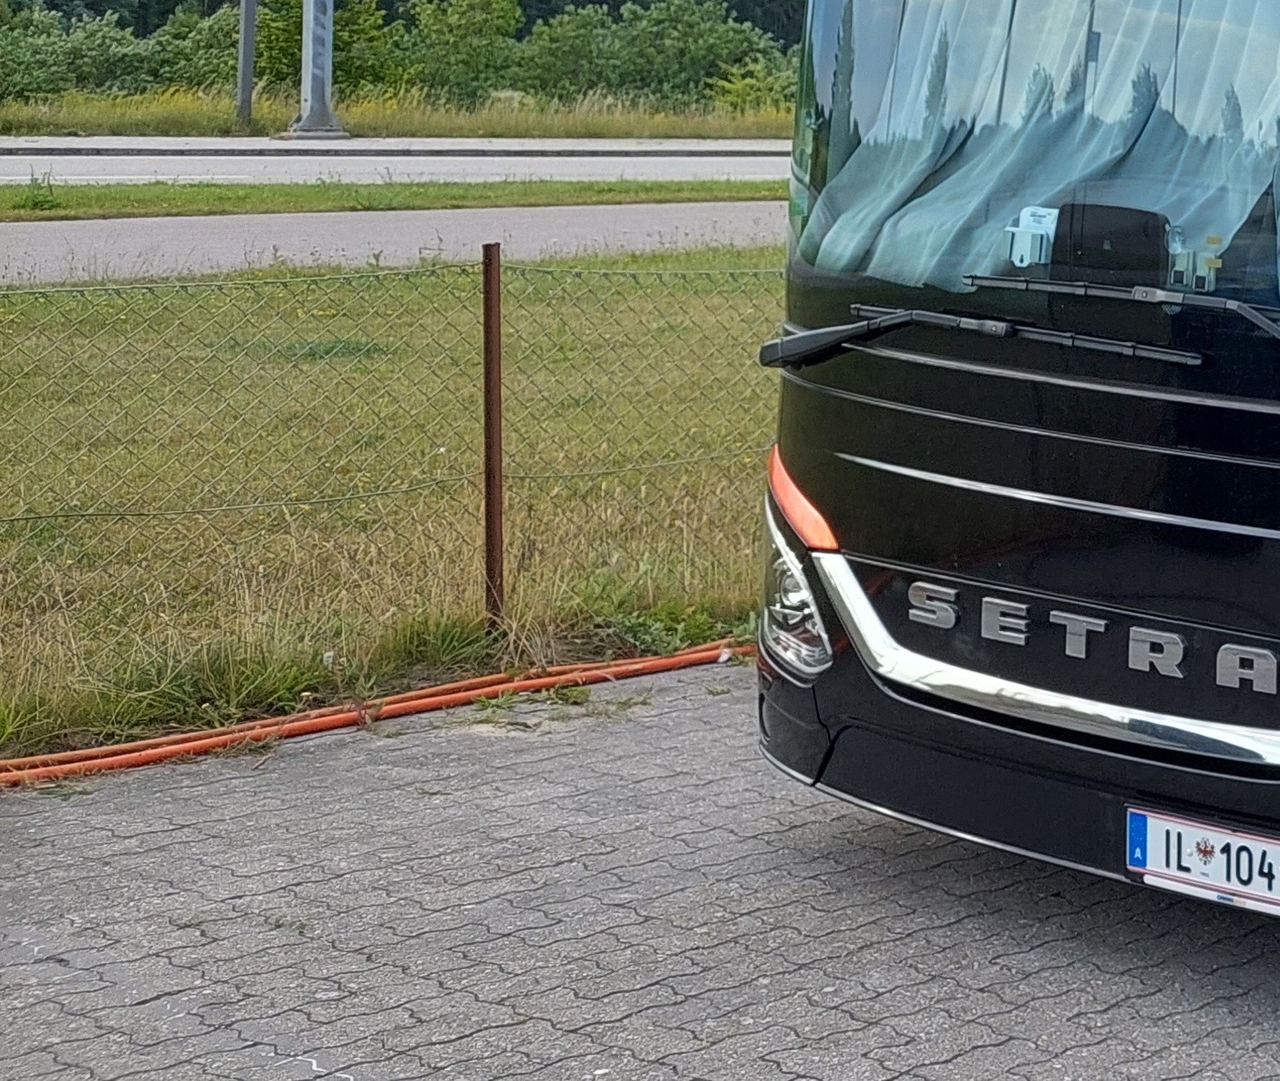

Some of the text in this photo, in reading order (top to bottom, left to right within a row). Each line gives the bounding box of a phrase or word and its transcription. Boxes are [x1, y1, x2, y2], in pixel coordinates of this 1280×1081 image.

[908, 581, 1279, 695] SETRA
[1165, 828, 1192, 873] IL
[1219, 841, 1276, 892] 104
